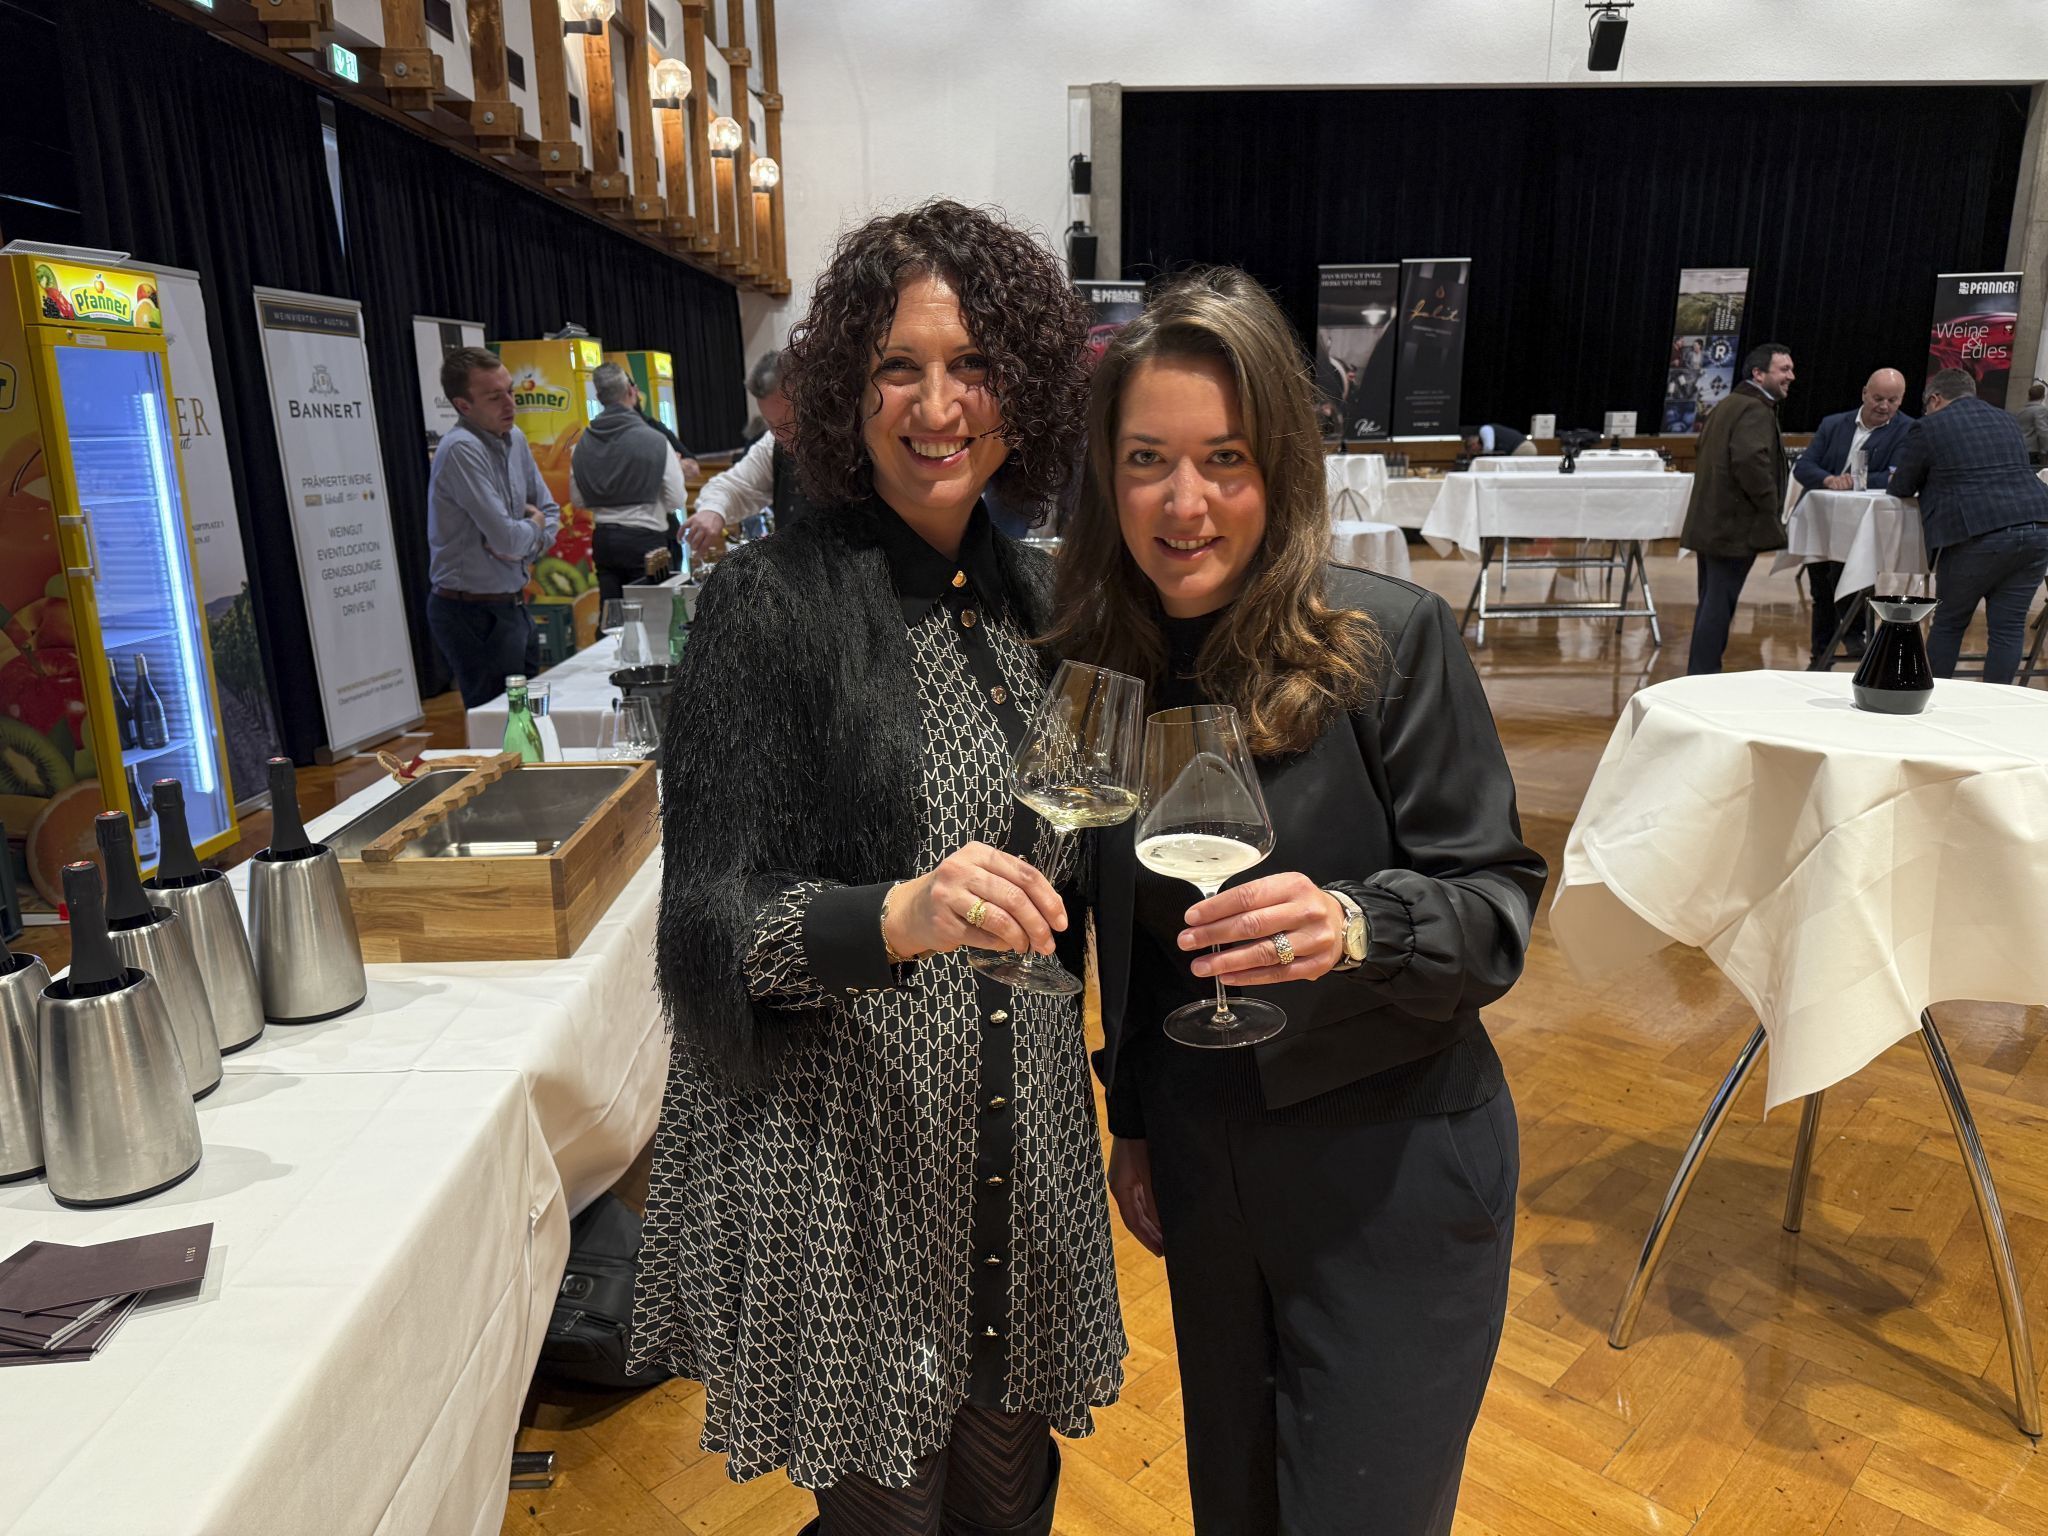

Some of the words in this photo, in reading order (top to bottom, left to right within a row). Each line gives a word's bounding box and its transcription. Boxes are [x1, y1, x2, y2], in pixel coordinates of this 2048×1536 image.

[1970, 281, 2015, 294] PFANNER
[1936, 322, 1989, 338] Weine
[1961, 343, 2007, 359] Edles
[514, 392, 566, 407] anner
[174, 397, 212, 437] ER
[288, 399, 362, 419] BANNERT
[328, 523, 362, 538] WEINGUT
[317, 541, 380, 560] EVENTLOCATION
[321, 559, 383, 580] GENUSSLOUNGE
[333, 579, 376, 598] SCHLAFGUT
[342, 601, 366, 616] DRIVE
